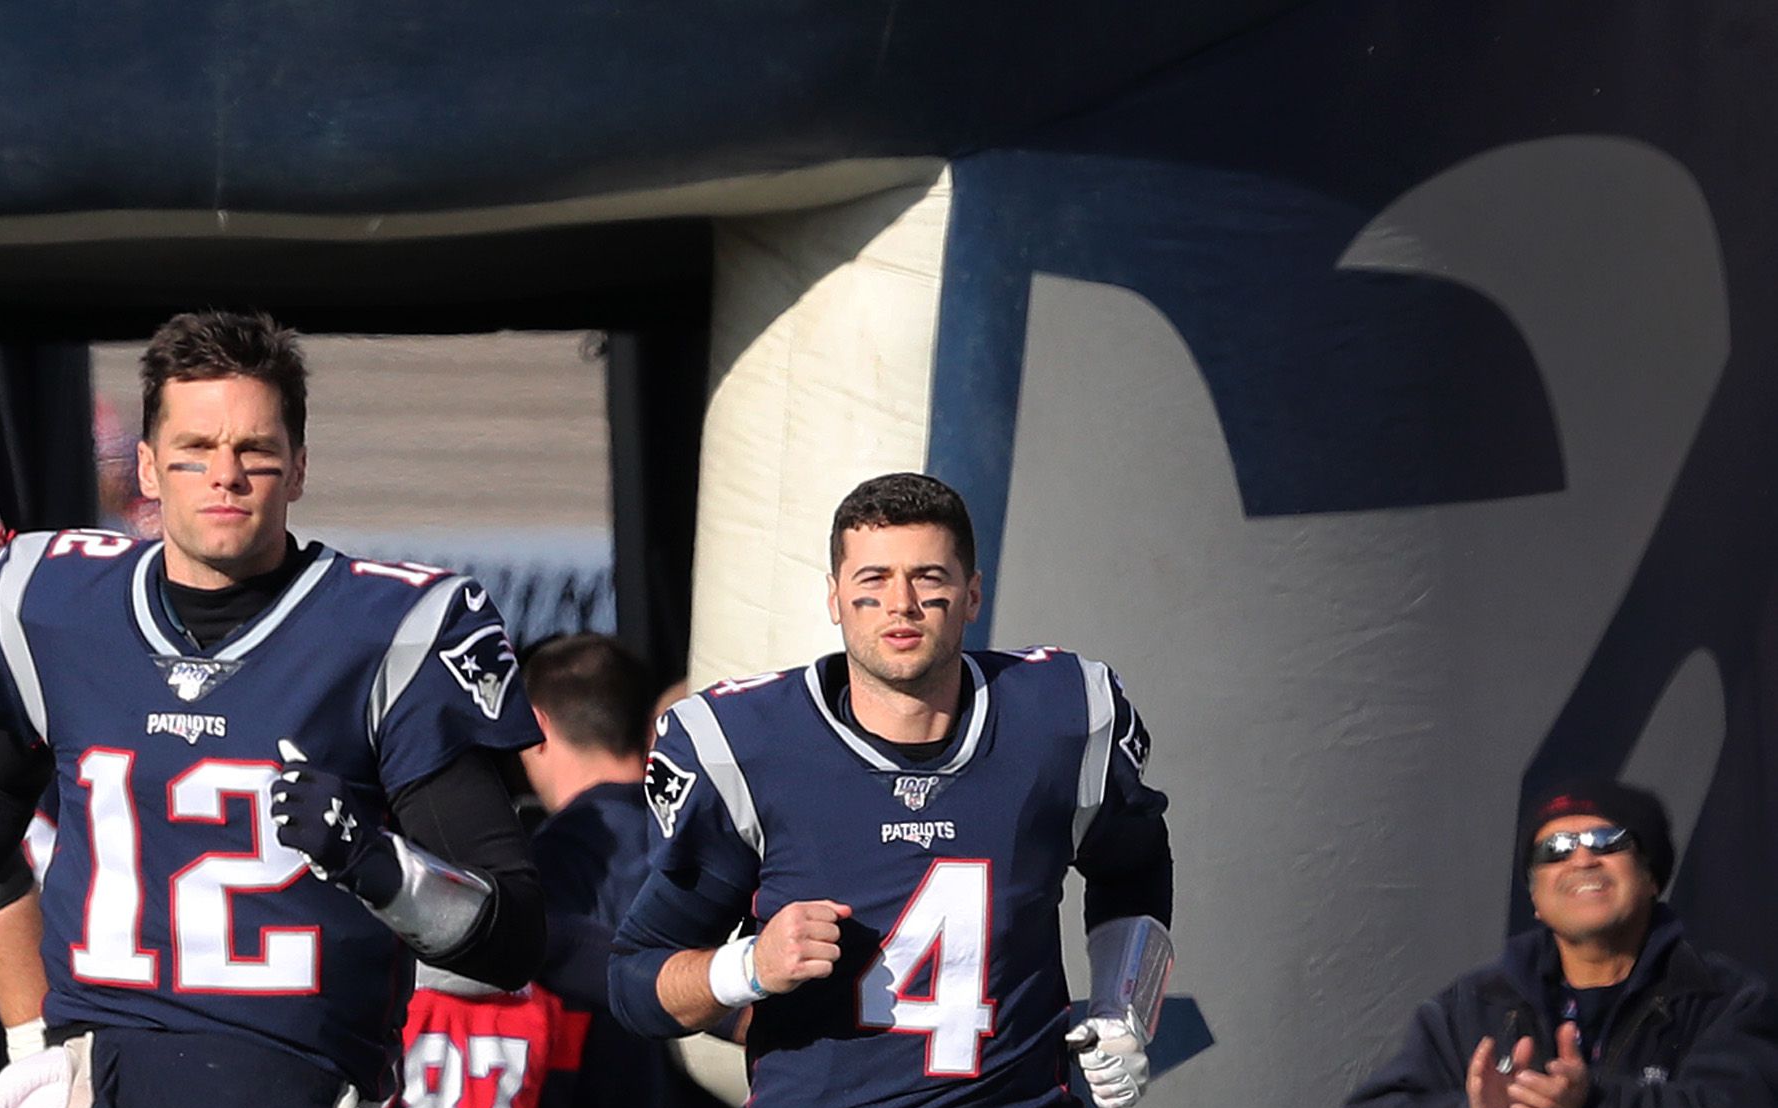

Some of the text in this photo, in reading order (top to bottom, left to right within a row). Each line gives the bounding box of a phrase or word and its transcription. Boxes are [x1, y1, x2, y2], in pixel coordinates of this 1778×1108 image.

[146, 713, 227, 740] PATRIOTS
[69, 745, 321, 996] 12
[881, 821, 956, 843] PATRIOTS
[856, 857, 998, 1079] 4
